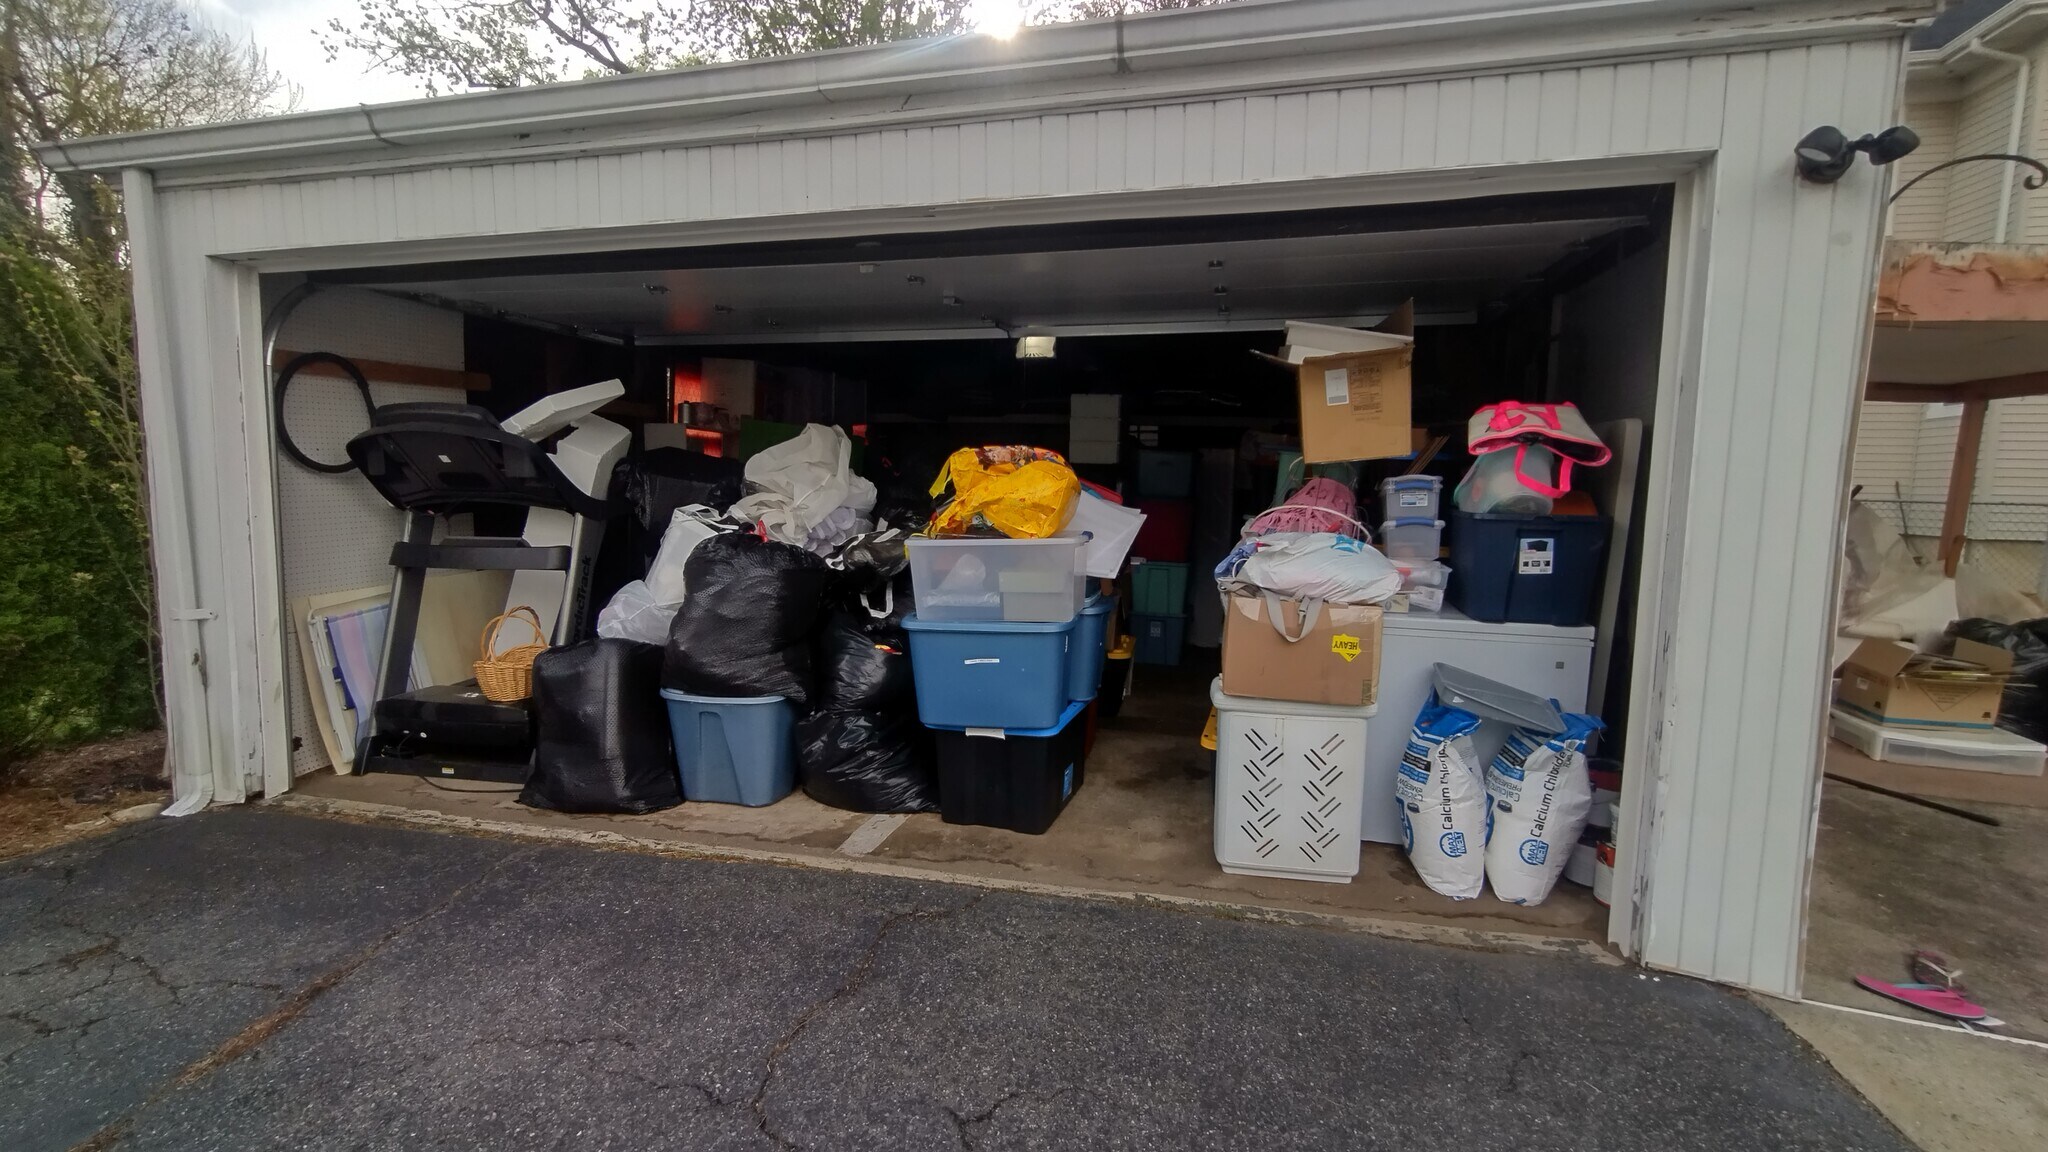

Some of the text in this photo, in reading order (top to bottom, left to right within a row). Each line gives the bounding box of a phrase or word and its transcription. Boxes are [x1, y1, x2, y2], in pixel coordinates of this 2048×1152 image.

[574, 555, 591, 642] ordicTrack
[1333, 641, 1358, 650] HEAVY
[1530, 751, 1566, 838] Calcium Chloride
[1440, 787, 1453, 830] Calcium
[1454, 832, 1466, 854] MELT
[1527, 843, 1538, 861] MAX
[1536, 841, 1548, 864] MELT
